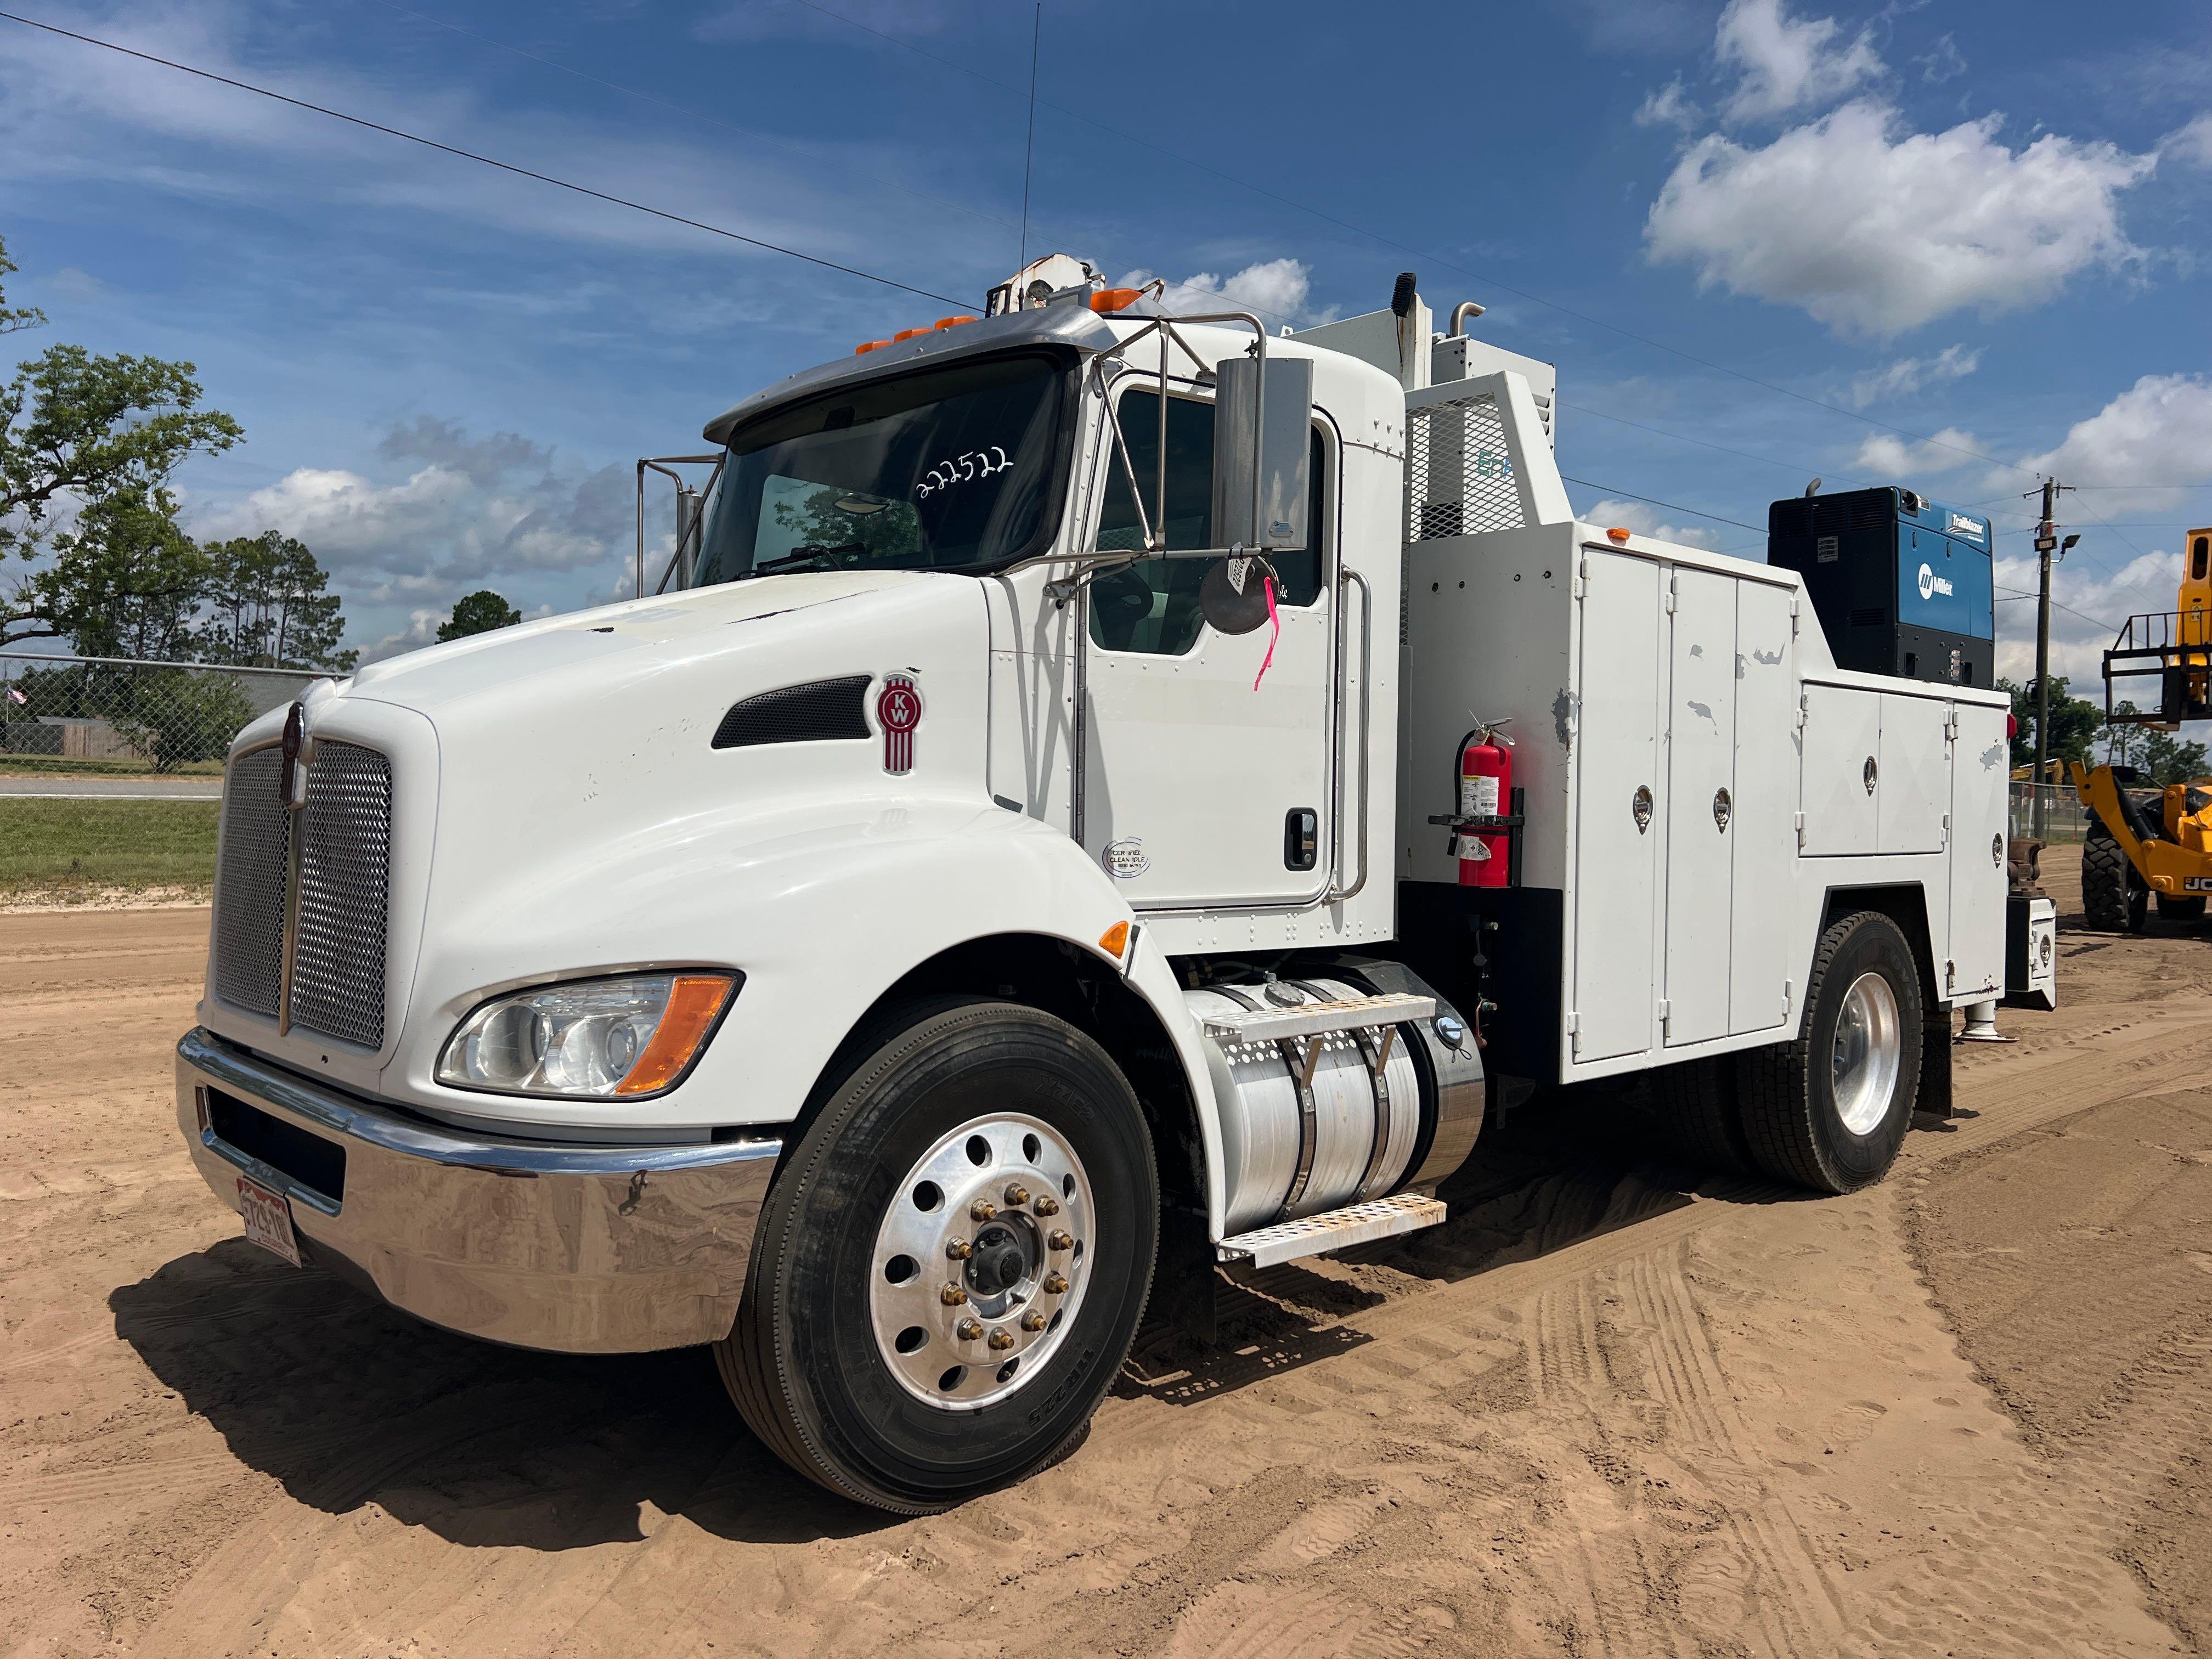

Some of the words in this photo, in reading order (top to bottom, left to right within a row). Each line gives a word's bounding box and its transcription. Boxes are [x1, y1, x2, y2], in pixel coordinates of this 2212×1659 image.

[916, 446, 1014, 498] 222522
[1953, 513, 1983, 534] Trailblazer
[1933, 575, 1953, 596] Miller
[1035, 1074, 1096, 1126] XZE2
